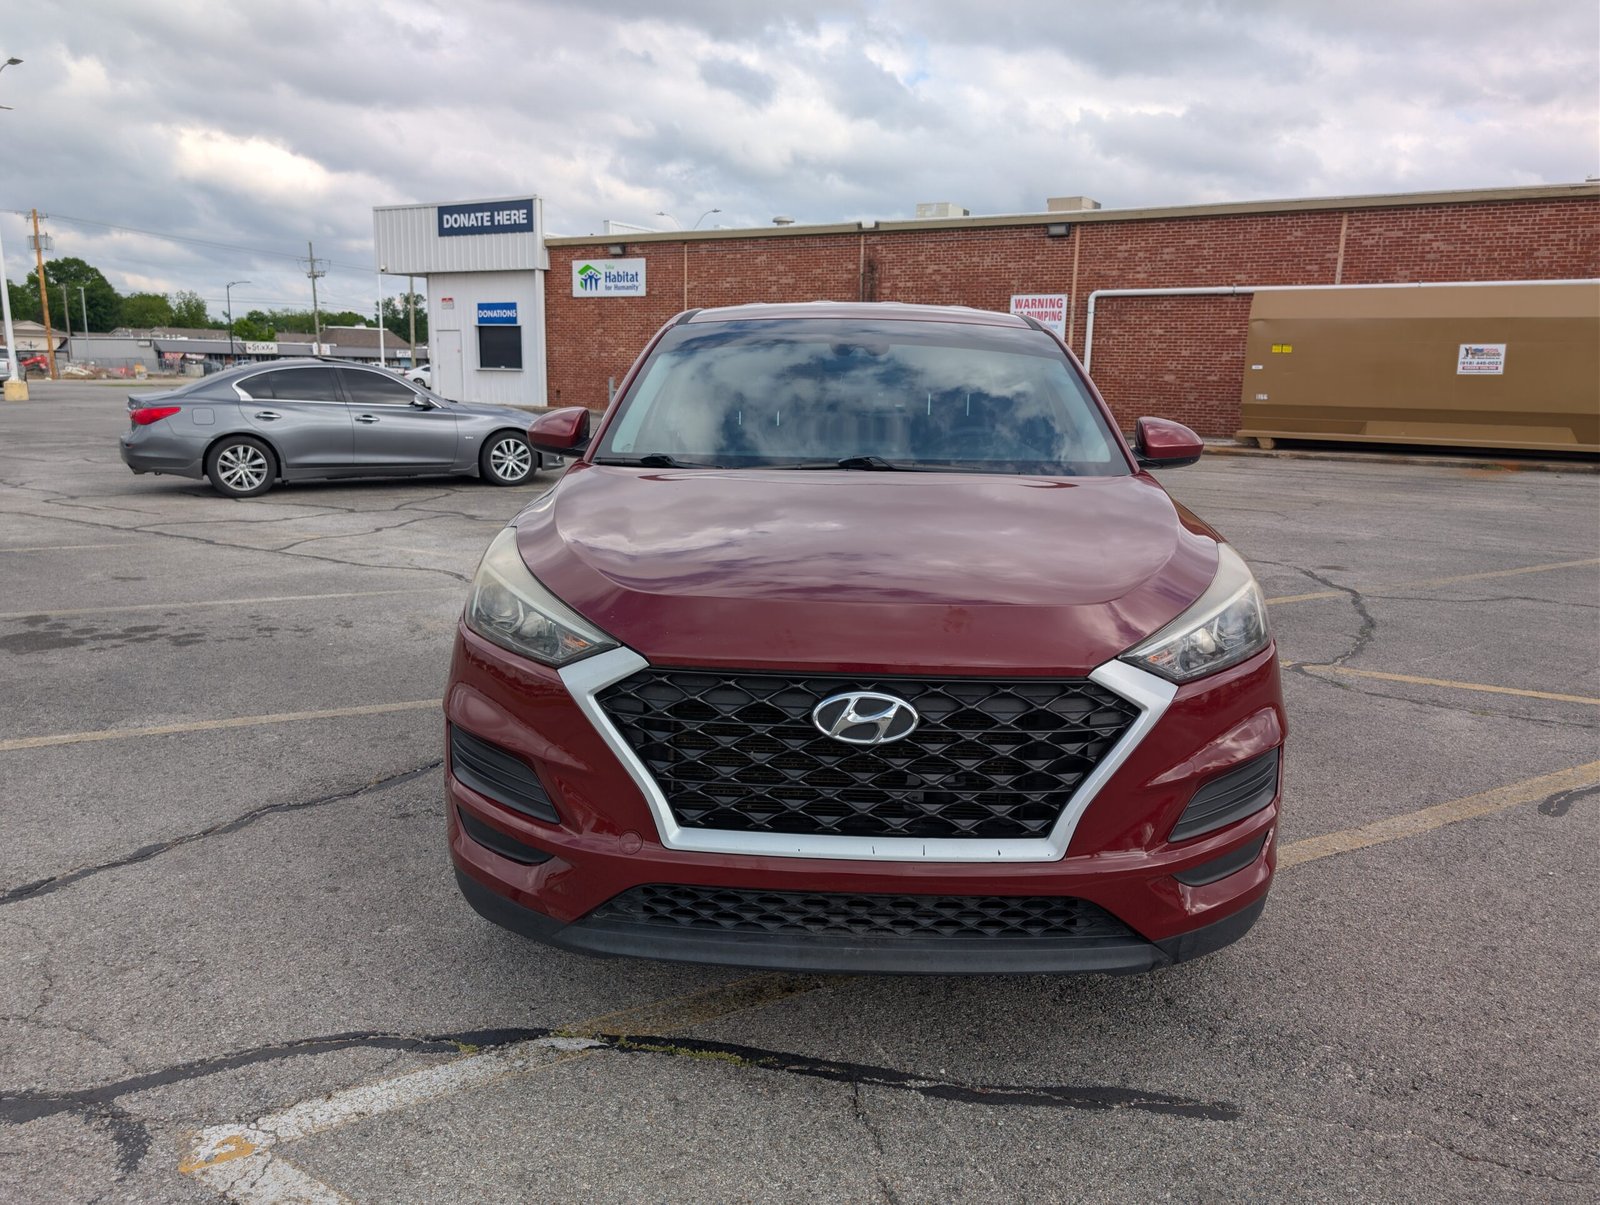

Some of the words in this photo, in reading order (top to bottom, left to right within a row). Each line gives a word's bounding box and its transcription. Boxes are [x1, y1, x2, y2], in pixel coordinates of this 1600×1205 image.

[442, 212, 491, 229] DONATE
[494, 209, 528, 226] HERE
[604, 271, 639, 283] Habitat
[613, 284, 639, 292] Humanity
[1014, 298, 1063, 309] WARNING
[478, 309, 517, 318] DONATIONS
